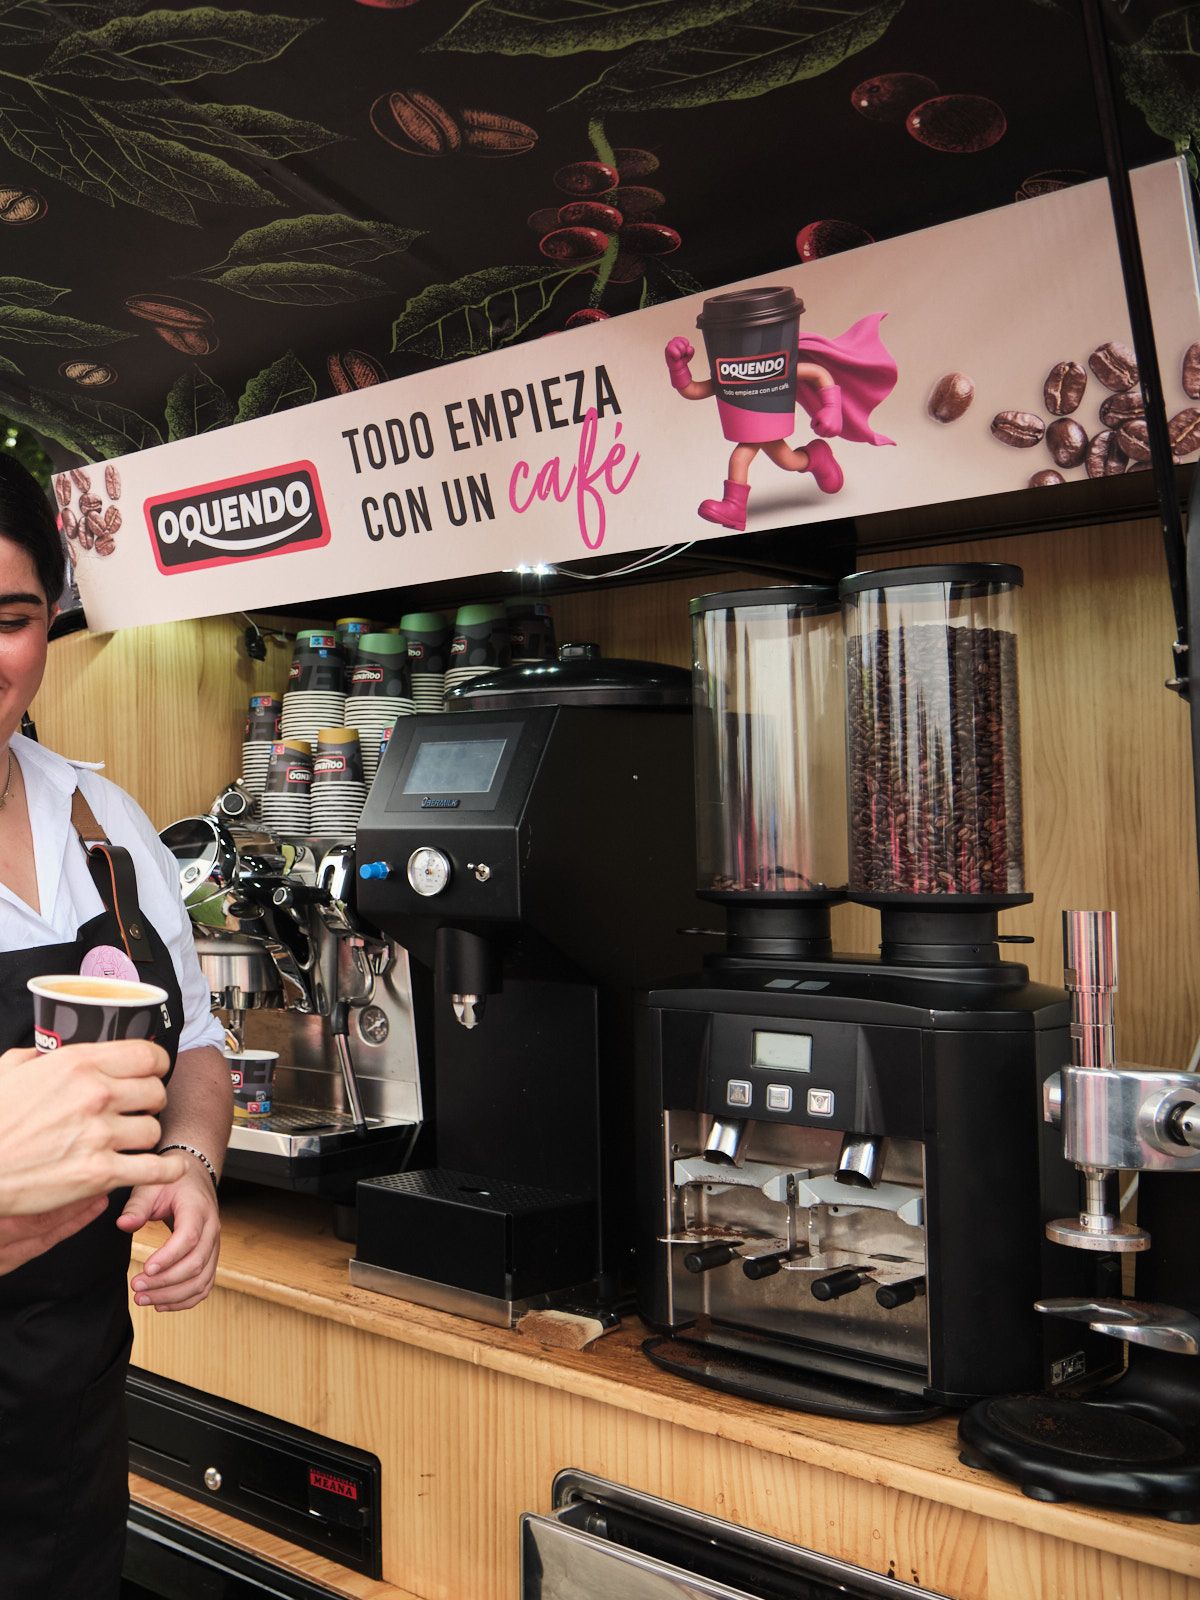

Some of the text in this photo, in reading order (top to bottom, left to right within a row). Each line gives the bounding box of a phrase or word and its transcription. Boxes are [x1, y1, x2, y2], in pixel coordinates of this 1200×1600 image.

[721, 357, 785, 380] OQUENDO
[735, 389, 759, 397] empieza
[342, 364, 622, 474] TODO EMPIEZA
[361, 406, 641, 550] CON UN café
[157, 480, 313, 550] OQUENDO
[313, 1475, 353, 1497] MEANA
